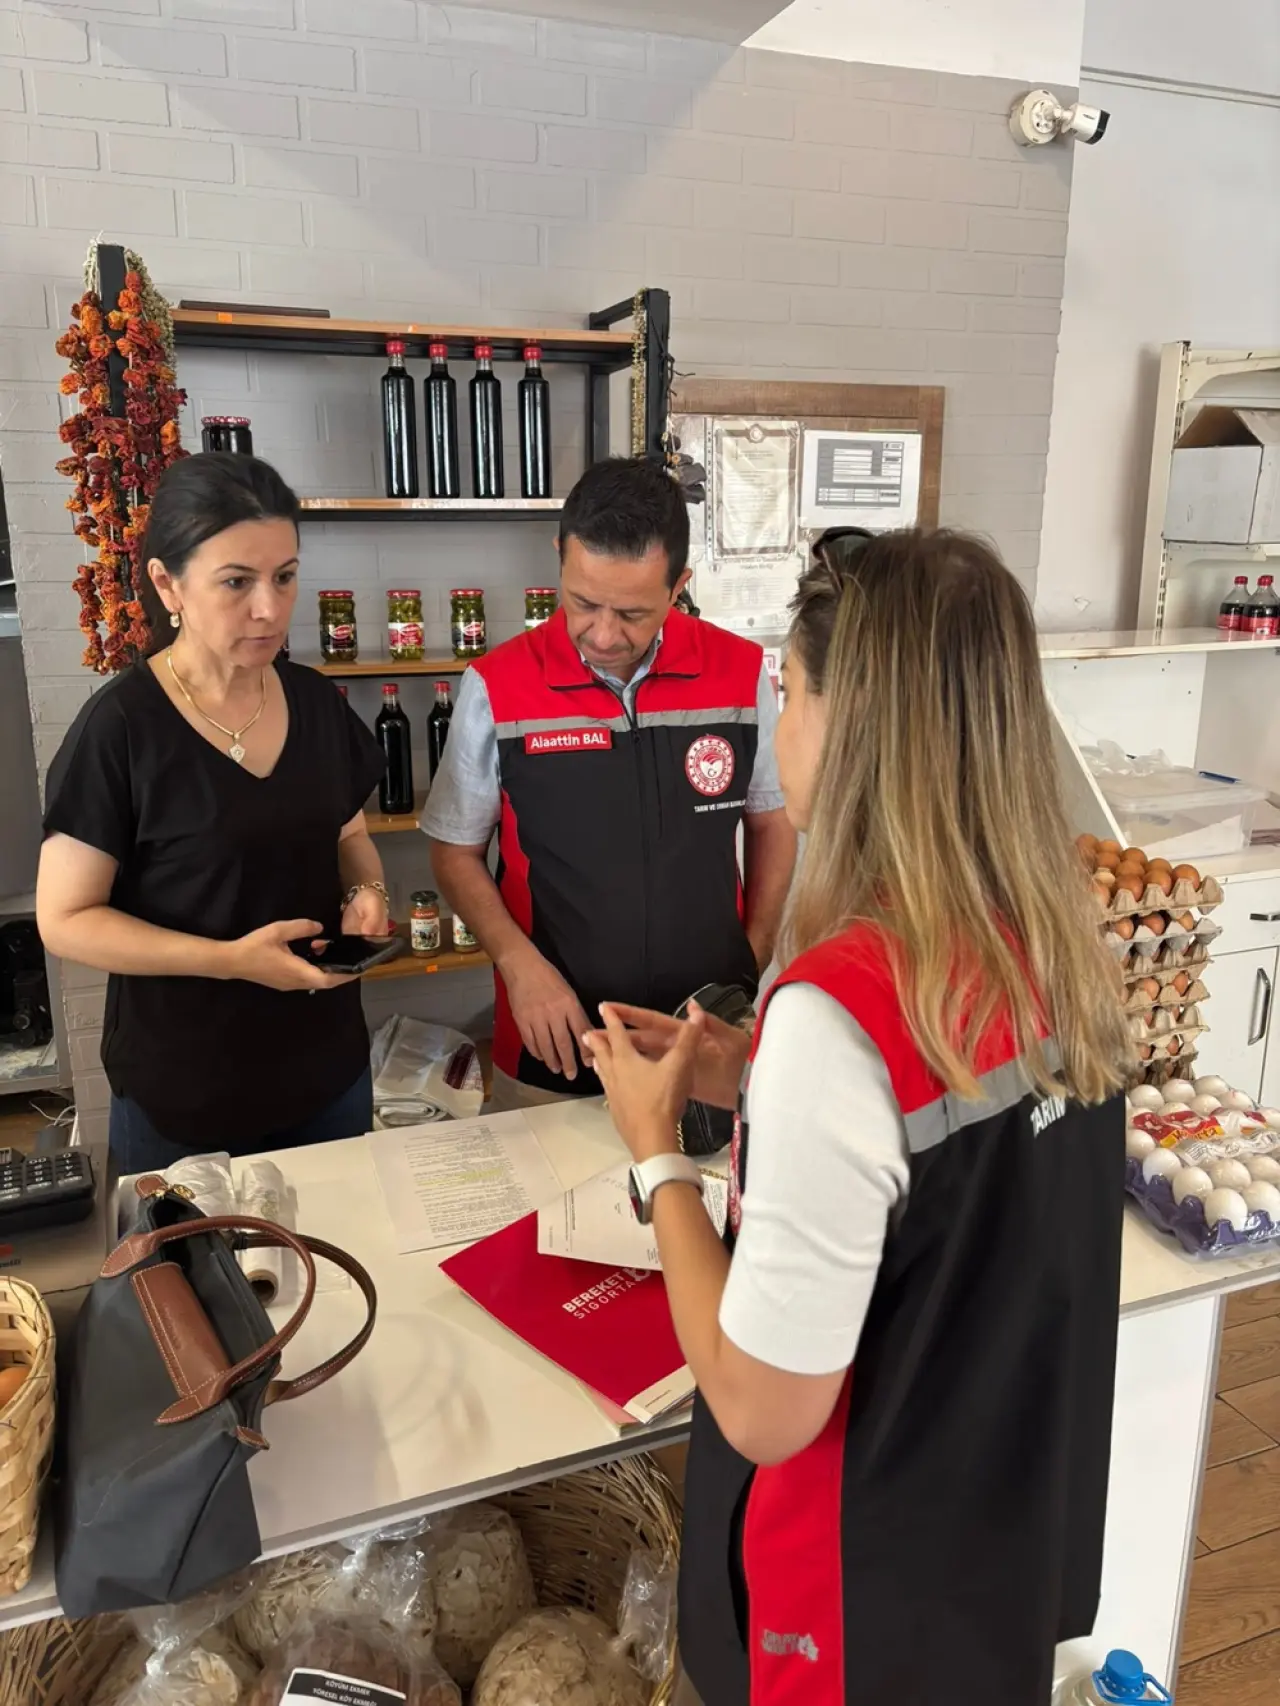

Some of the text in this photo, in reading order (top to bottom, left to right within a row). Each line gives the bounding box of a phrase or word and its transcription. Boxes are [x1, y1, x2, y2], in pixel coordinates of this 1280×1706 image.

[531, 732, 607, 749] Alaattin BAL
[562, 1271, 625, 1312] BEREKET
